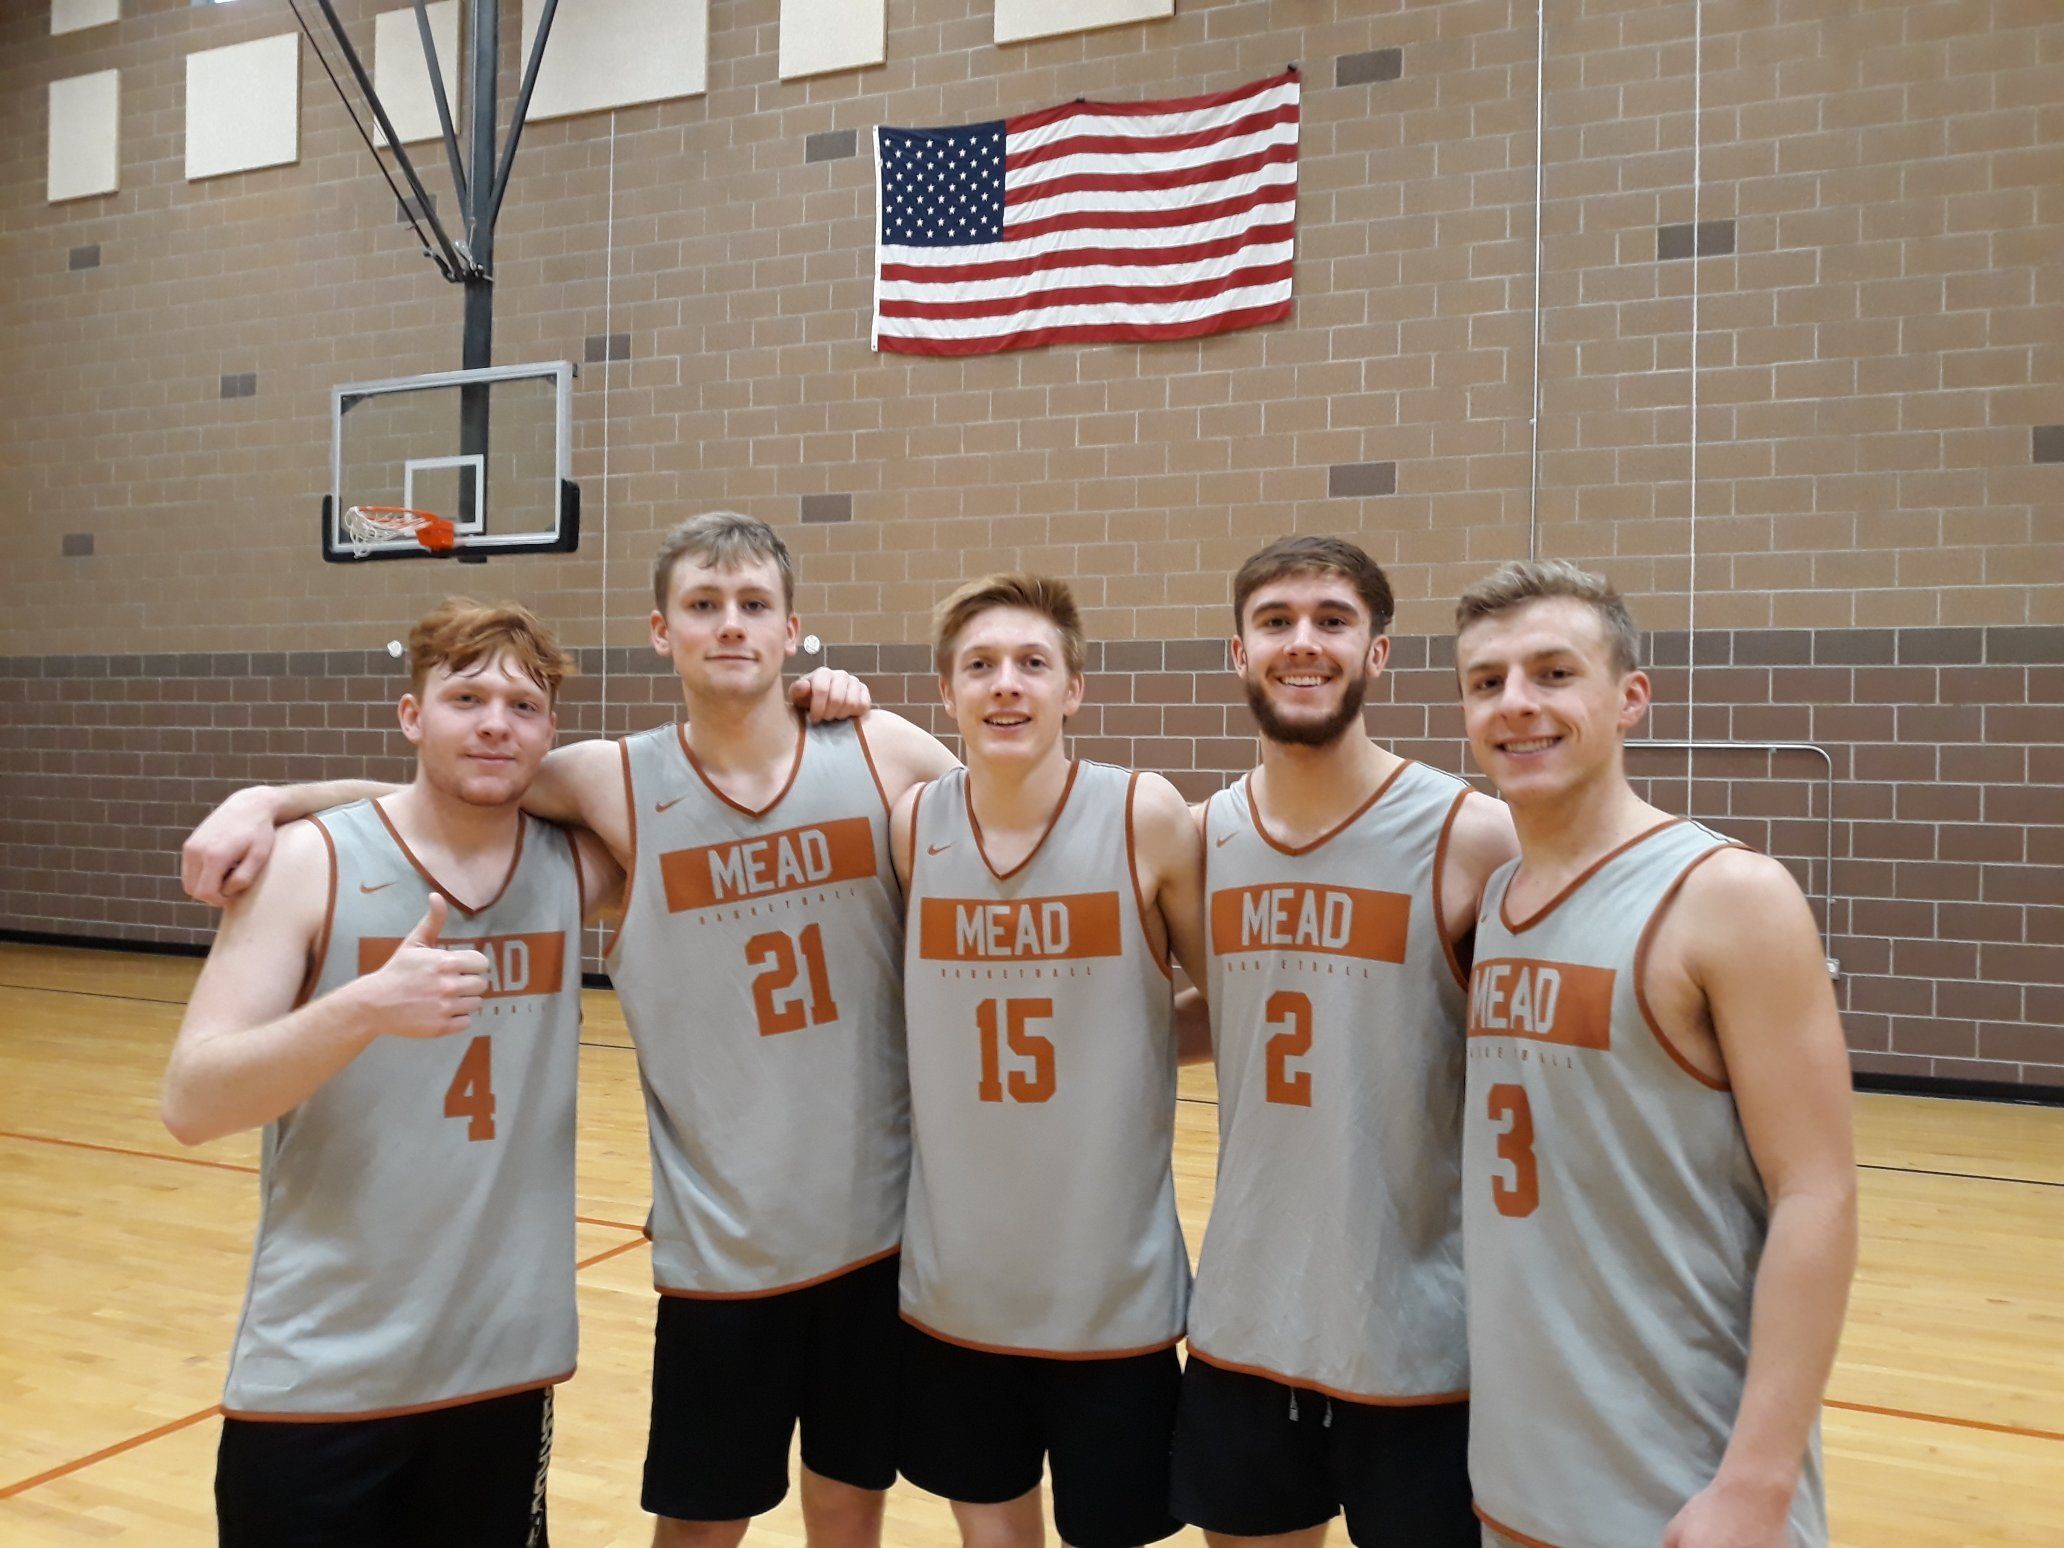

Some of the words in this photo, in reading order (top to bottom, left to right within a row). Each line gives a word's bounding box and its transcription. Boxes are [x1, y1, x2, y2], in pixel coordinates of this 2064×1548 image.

[708, 829, 832, 900] MEAD
[955, 902, 1070, 956] MEAD
[1241, 888, 1353, 949] MEAD
[437, 940, 529, 992] AD
[744, 922, 839, 1037] 21
[1470, 964, 1562, 1034] MEAD
[443, 1036, 496, 1142] 4
[976, 998, 1057, 1103] 15
[1265, 990, 1313, 1108] 2
[1487, 1082, 1540, 1218] 3
